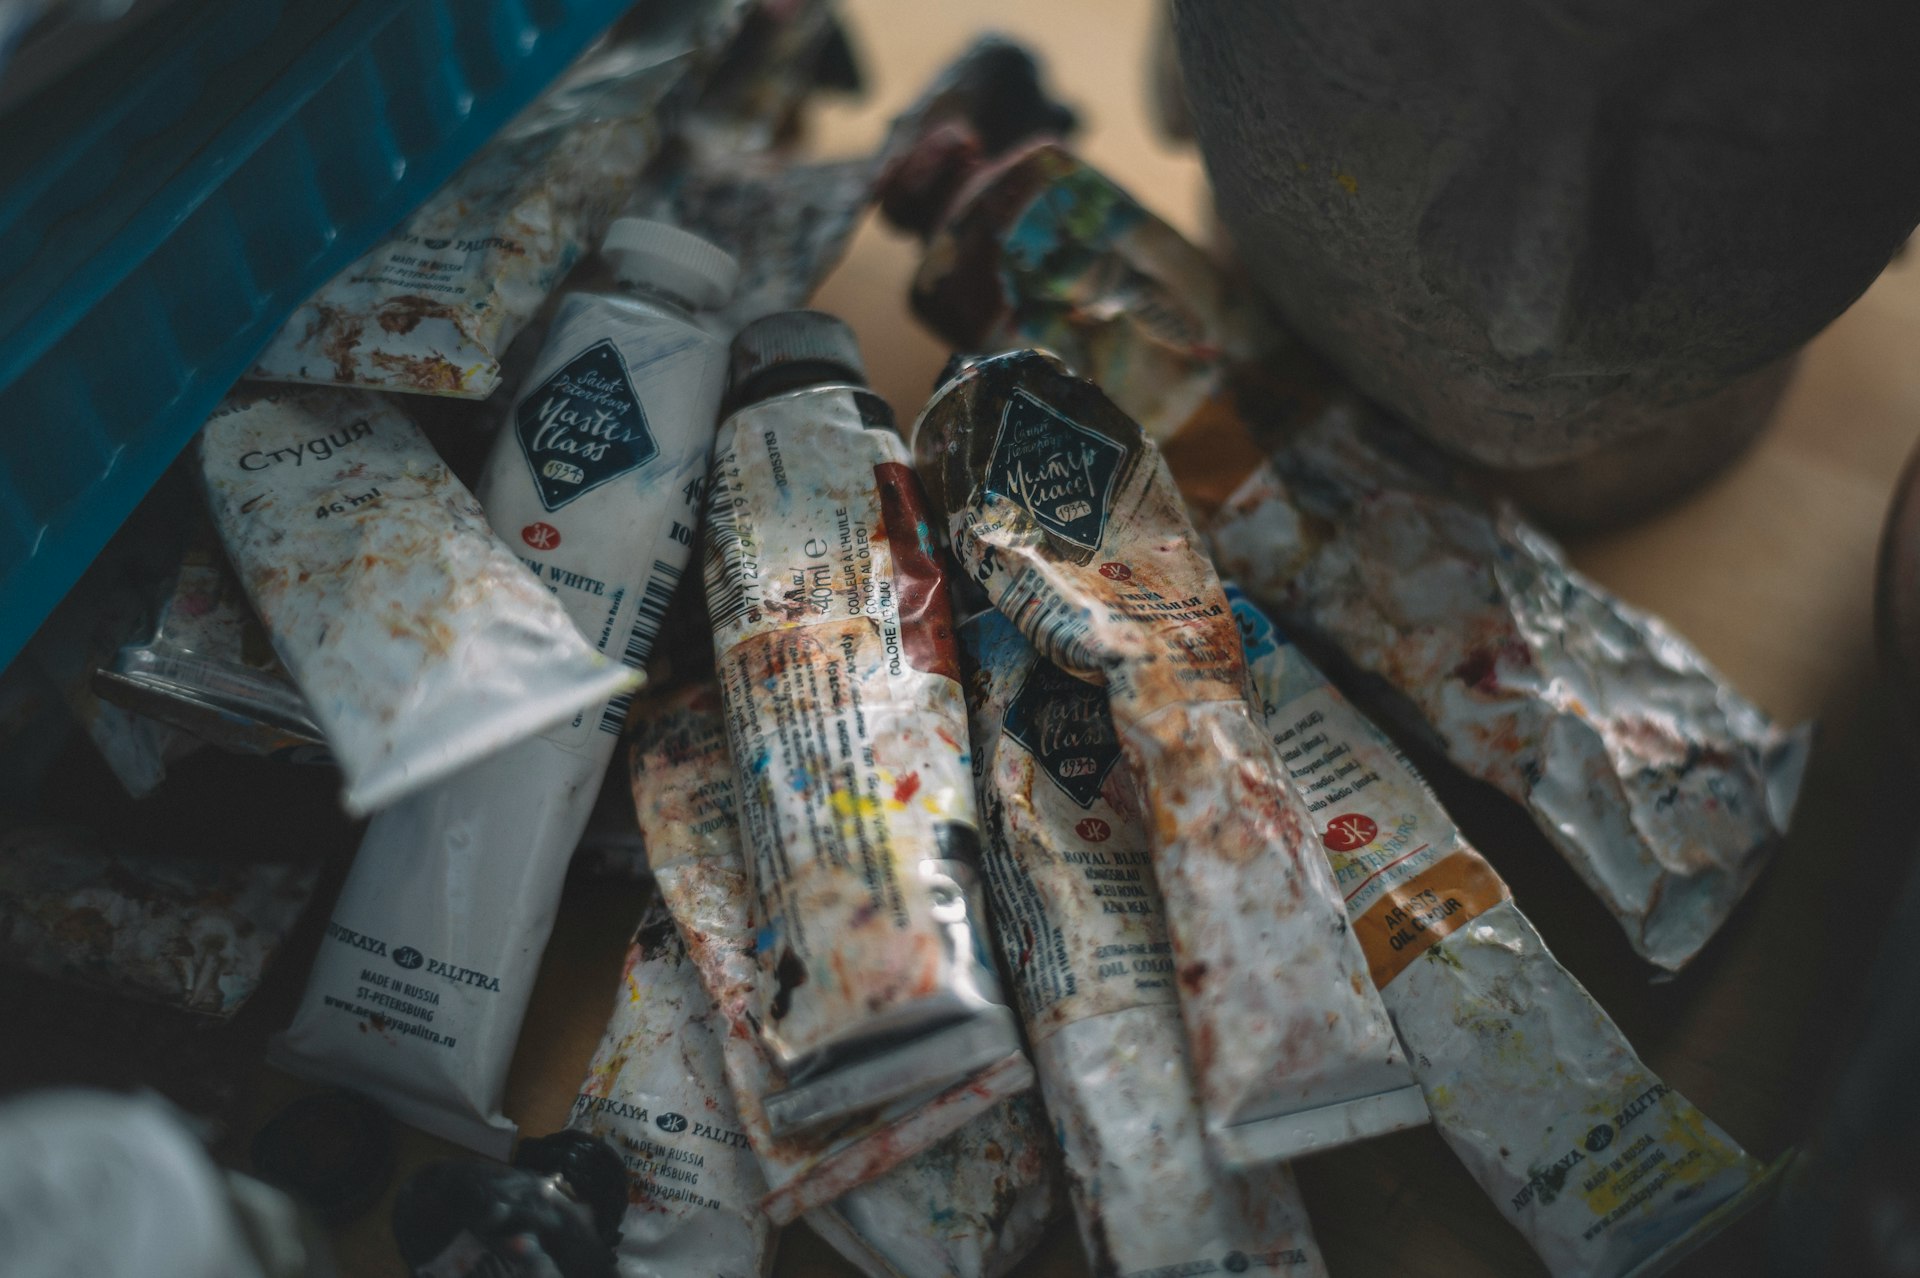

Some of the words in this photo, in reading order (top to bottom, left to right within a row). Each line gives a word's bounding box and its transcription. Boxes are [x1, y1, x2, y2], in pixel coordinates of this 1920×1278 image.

[239, 418, 374, 471] Студия
[533, 421, 611, 461] Class
[316, 502, 346, 520] 46
[550, 565, 606, 597] WHITE
[860, 560, 871, 574] AL
[845, 564, 861, 615] COULEUR
[885, 627, 903, 677] COLORE
[1273, 725, 1297, 746] dium
[1063, 851, 1110, 865] ROYAL
[327, 922, 388, 958] EVSKAYA
[426, 958, 501, 993] PALITRA
[356, 986, 434, 1022] ST-PETERSBURG
[360, 968, 391, 990] MADE
[391, 978, 403, 992] IN
[403, 983, 440, 1006] RUSSIA
[324, 995, 457, 1048] www.nevkayapalitra.ru
[577, 1093, 650, 1123] EVSKAYA
[625, 1136, 652, 1153] MADE
[654, 1143, 667, 1157] IN
[668, 1147, 705, 1169] RUSSIA
[623, 1154, 699, 1186] ST-PETERSBURG
